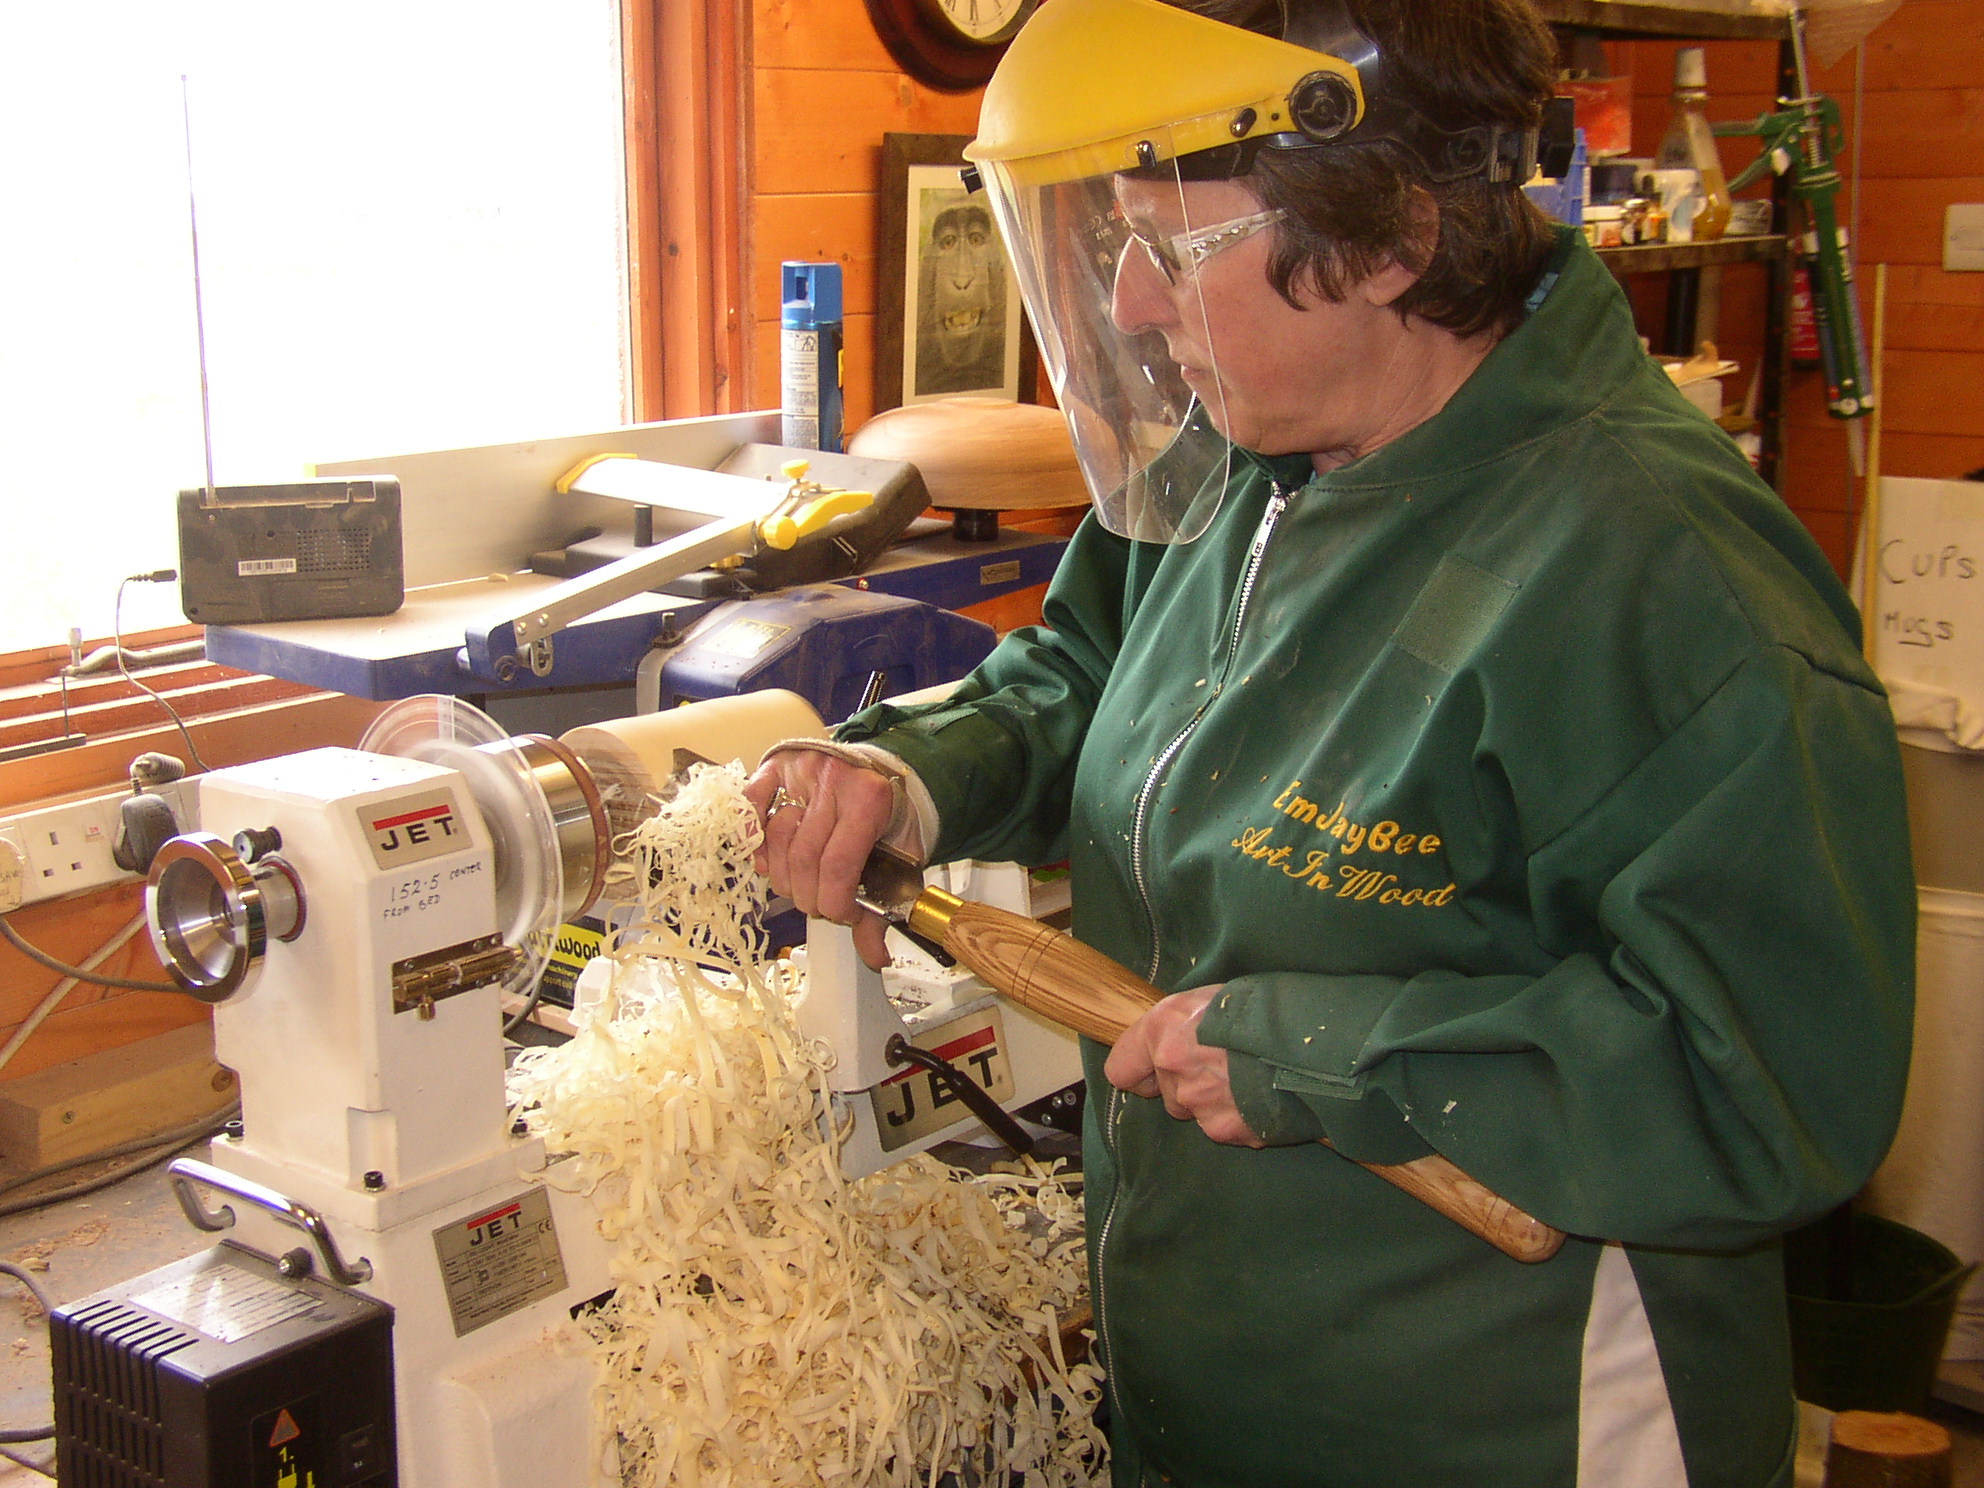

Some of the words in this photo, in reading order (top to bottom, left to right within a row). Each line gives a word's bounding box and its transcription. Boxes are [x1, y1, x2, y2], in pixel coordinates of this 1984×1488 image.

[380, 815, 454, 852] JET
[1231, 826, 1295, 868] Art
[1282, 850, 1334, 891] In
[1335, 864, 1458, 907] Wood
[886, 1046, 998, 1127] JET
[469, 1210, 522, 1247] JET
